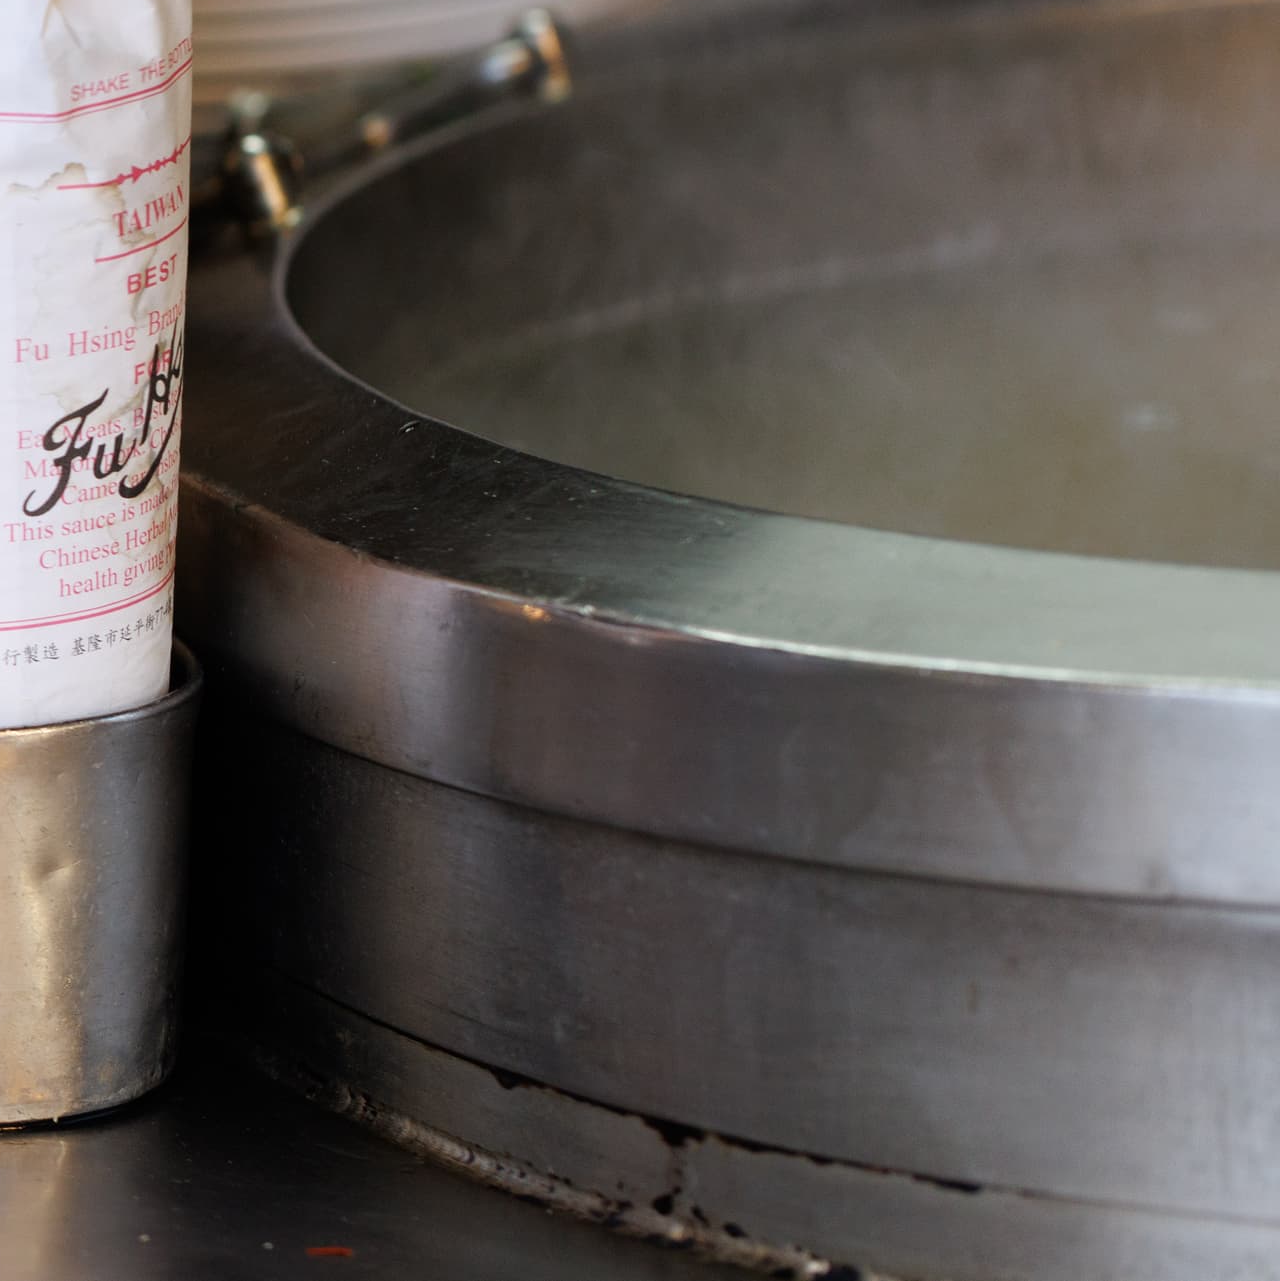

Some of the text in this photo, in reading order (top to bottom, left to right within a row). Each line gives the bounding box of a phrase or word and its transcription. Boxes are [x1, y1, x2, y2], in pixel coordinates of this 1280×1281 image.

[70, 73, 130, 102] SHAKE
[138, 58, 166, 83] THE
[127, 253, 178, 295] BEST
[15, 337, 50, 364] Fu
[68, 325, 138, 358] Hsing
[132, 400, 164, 428] Bst
[22, 387, 138, 517] Fu
[4, 520, 54, 543] This
[61, 511, 116, 537] sauce
[122, 502, 136, 523] is
[140, 489, 170, 516] made
[39, 541, 121, 570] Chinese
[125, 512, 168, 552] Herbal
[59, 567, 118, 598] health
[123, 550, 164, 587] giving
